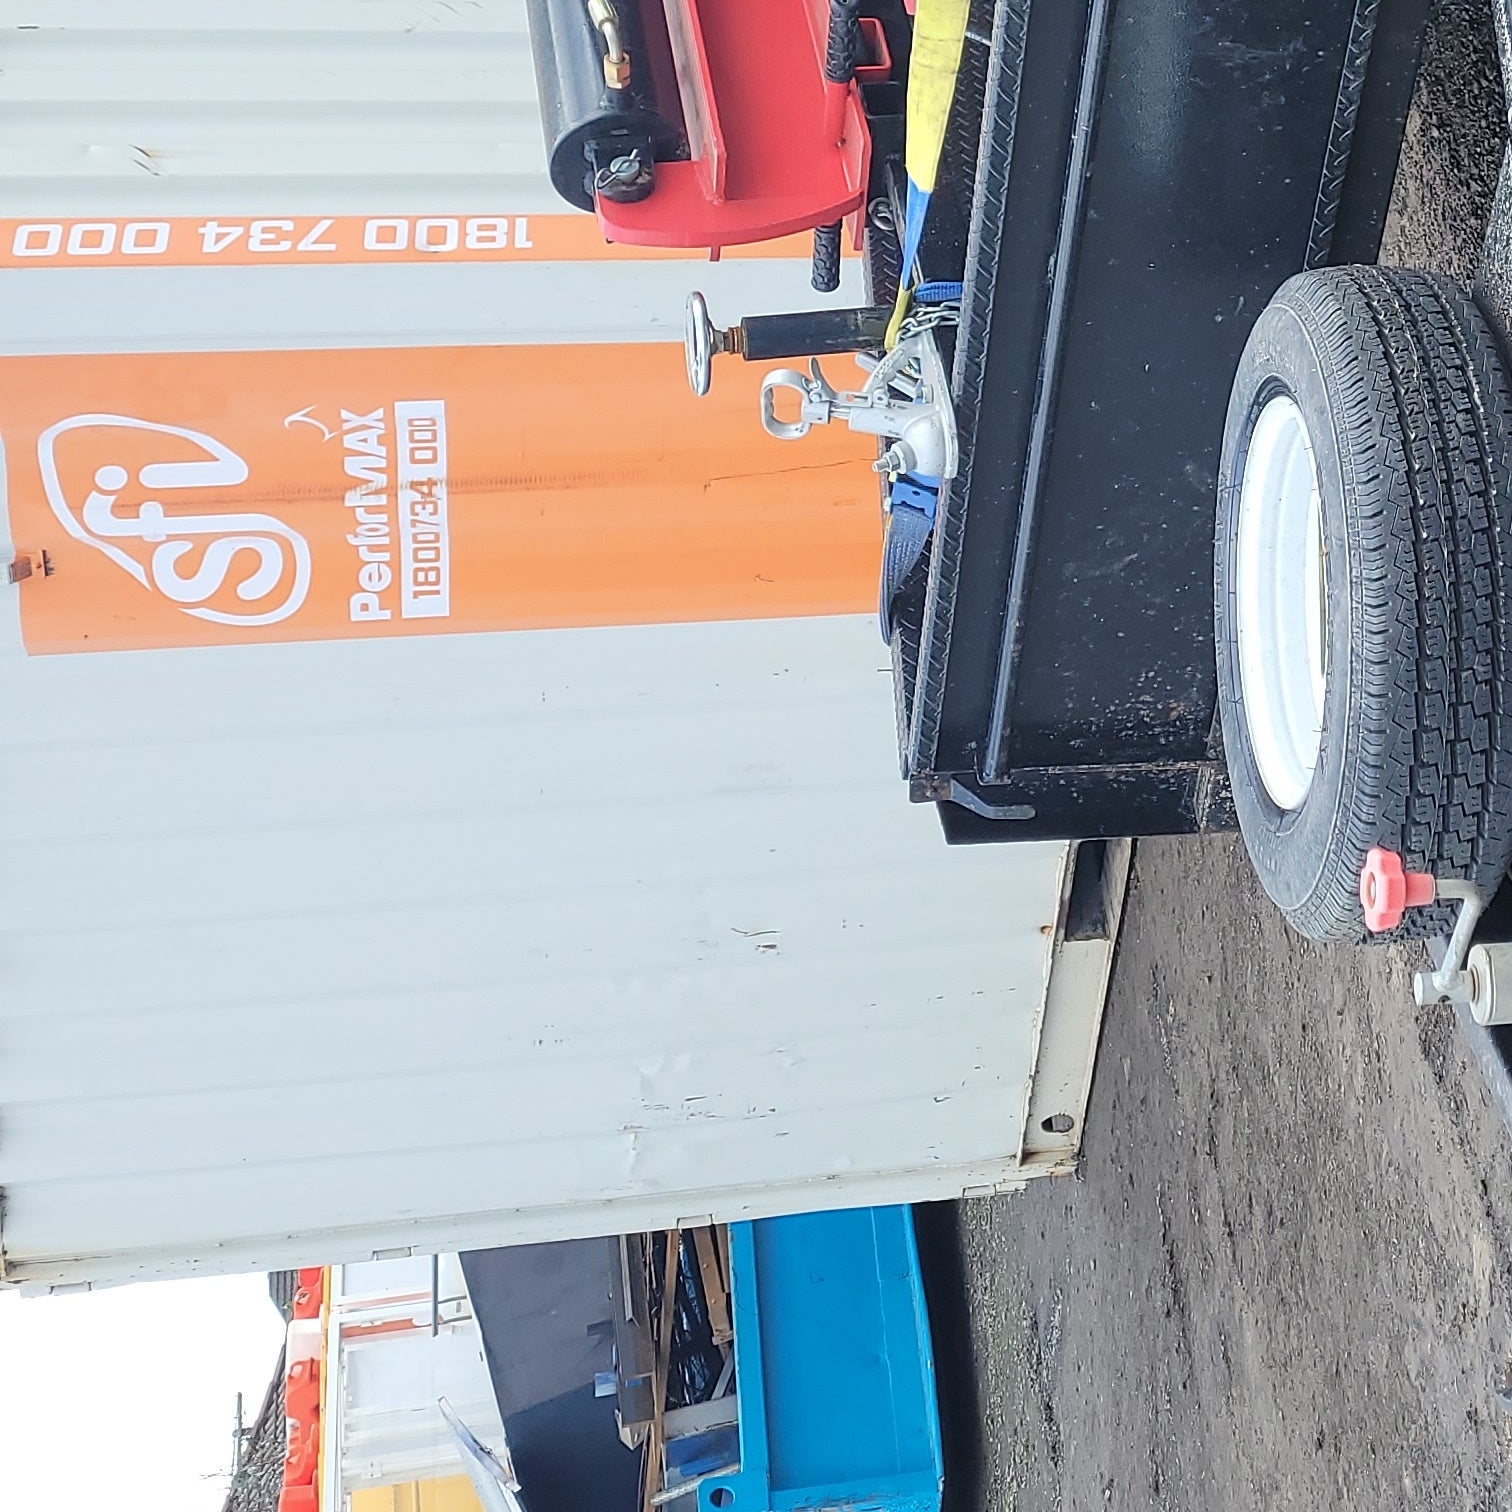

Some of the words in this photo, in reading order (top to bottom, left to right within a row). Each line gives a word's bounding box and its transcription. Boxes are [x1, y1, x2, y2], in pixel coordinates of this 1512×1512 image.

[12, 221, 171, 258] 000
[198, 219, 338, 254] 734
[363, 216, 534, 253] 1800
[340, 407, 392, 621] PerforMAX
